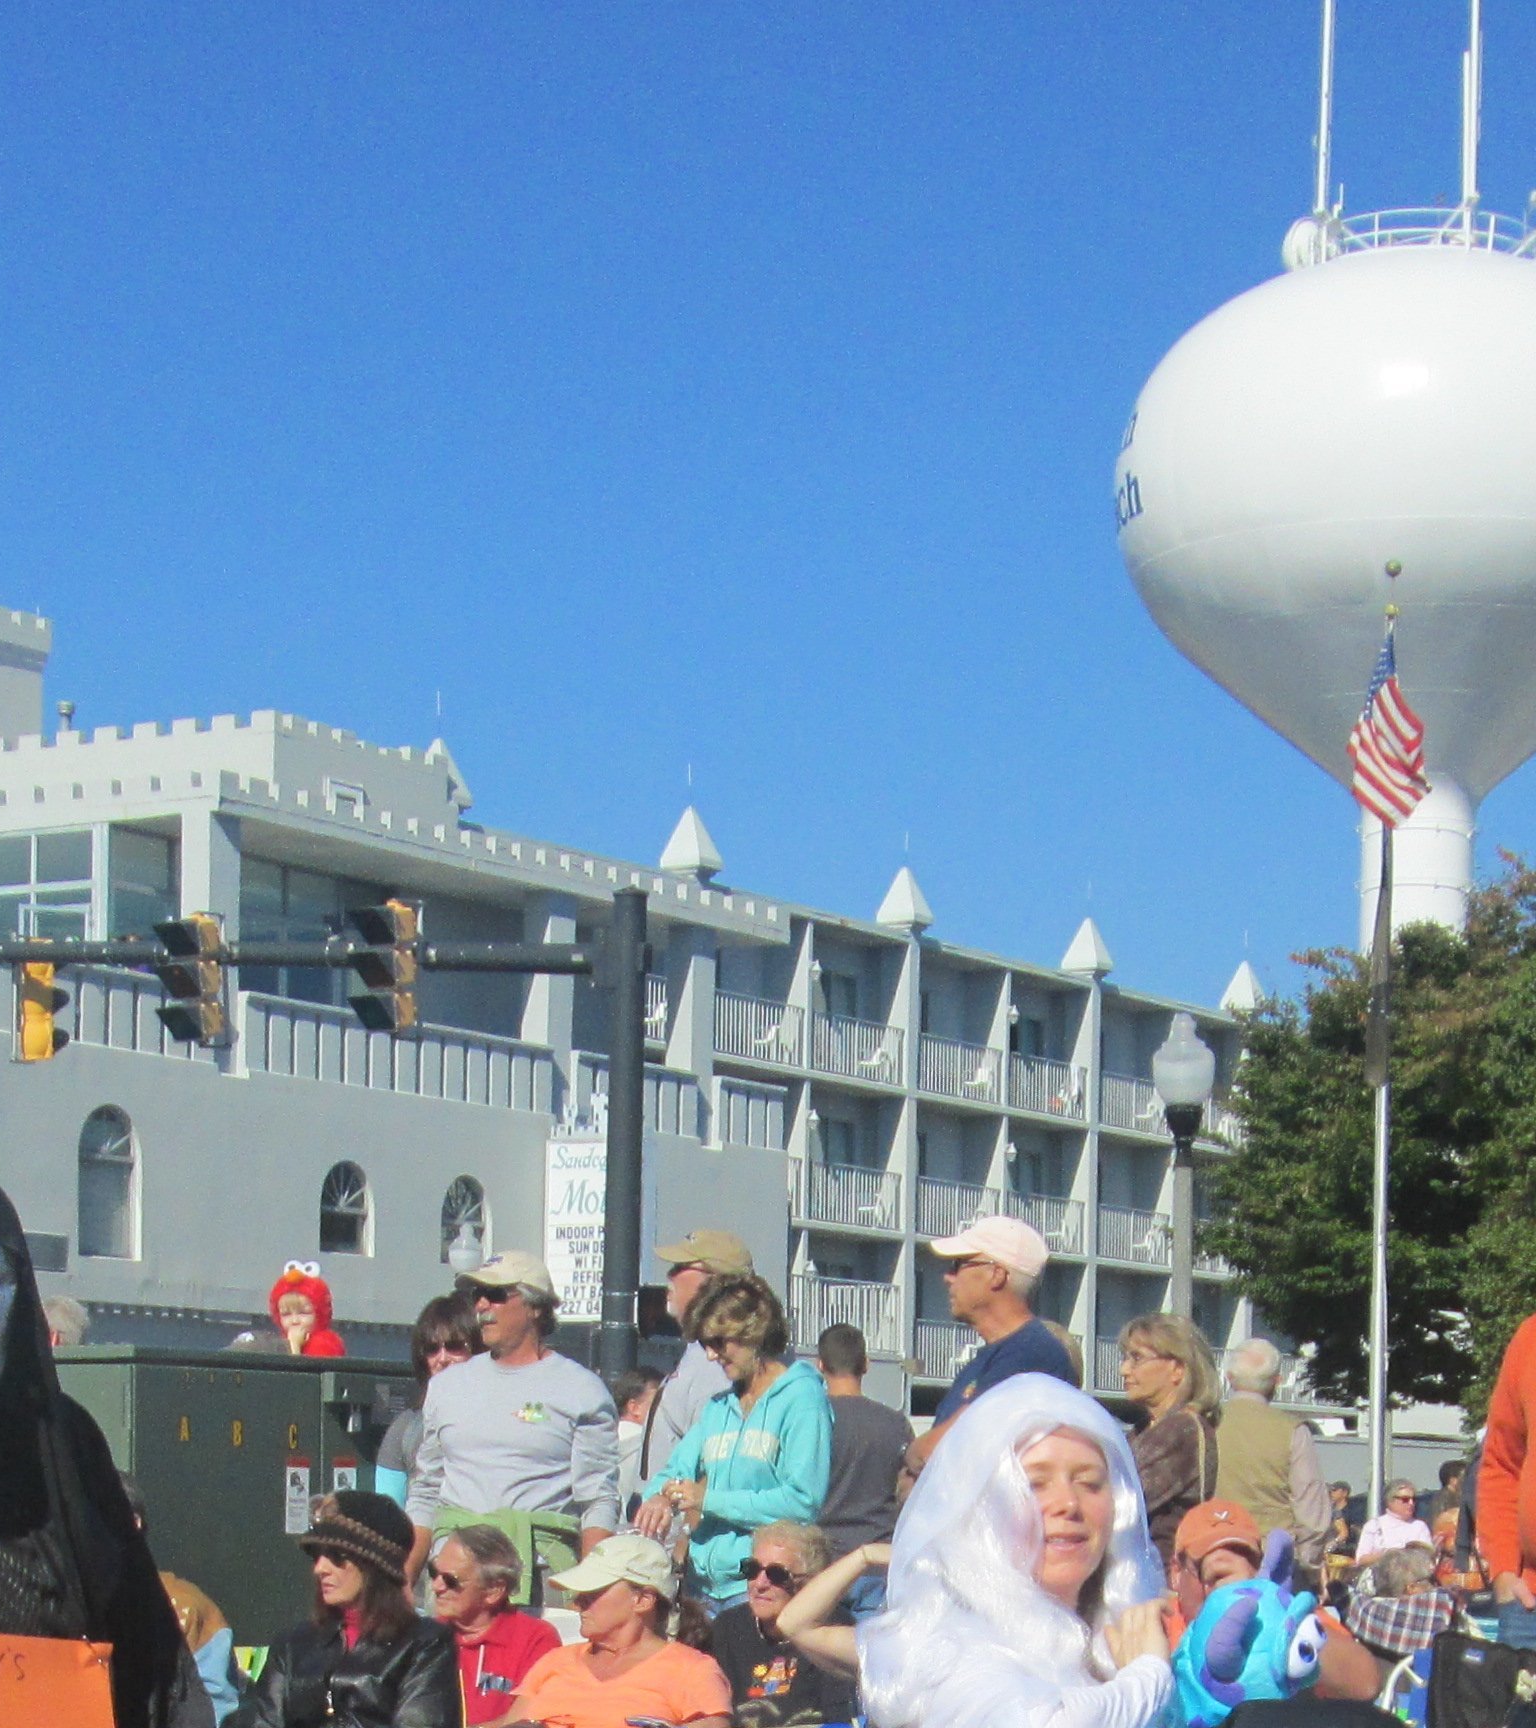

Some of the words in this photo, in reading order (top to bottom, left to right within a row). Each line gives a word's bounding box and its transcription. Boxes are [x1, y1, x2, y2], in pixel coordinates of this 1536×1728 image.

[556, 1226, 595, 1240] INDOOR
[568, 1240, 590, 1254] SUN
[575, 1255, 587, 1269] WI
[592, 1255, 602, 1269] FI
[564, 1286, 586, 1299] PVT
[561, 1300, 581, 1314] 227
[179, 1415, 190, 1441] A
[231, 1420, 243, 1447] B
[288, 1423, 298, 1449] C
